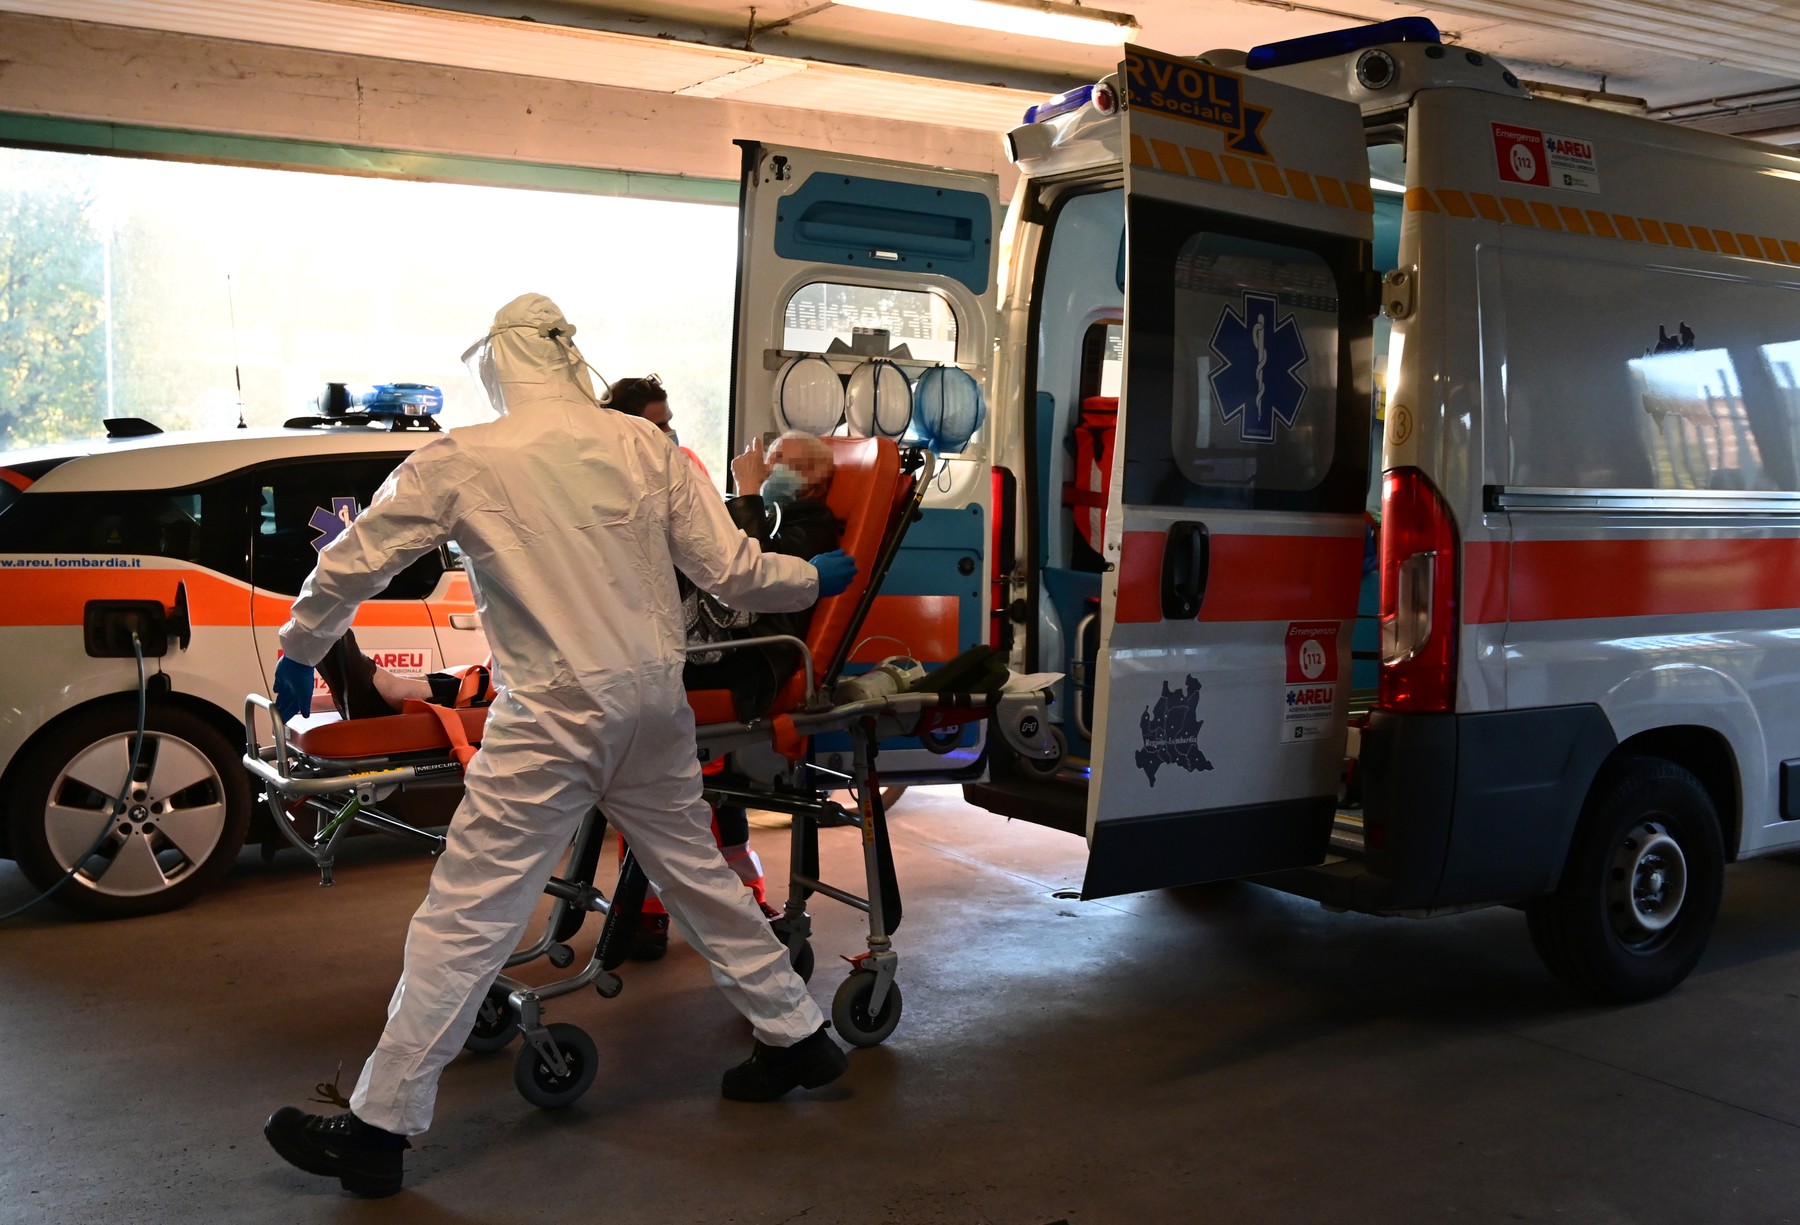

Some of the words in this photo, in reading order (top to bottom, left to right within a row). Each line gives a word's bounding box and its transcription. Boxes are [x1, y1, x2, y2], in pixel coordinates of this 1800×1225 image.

[1151, 92, 1234, 123] Sociale
[1495, 127, 1541, 143] Emergenza
[1556, 139, 1592, 159] AREU
[1517, 156, 1532, 169] 112
[0, 557, 141, 568] w.areu.lombardia.it
[1289, 626, 1336, 637] Emergenza
[373, 653, 423, 668] AREU
[1307, 653, 1322, 665] 112
[1295, 688, 1333, 706] AREU
